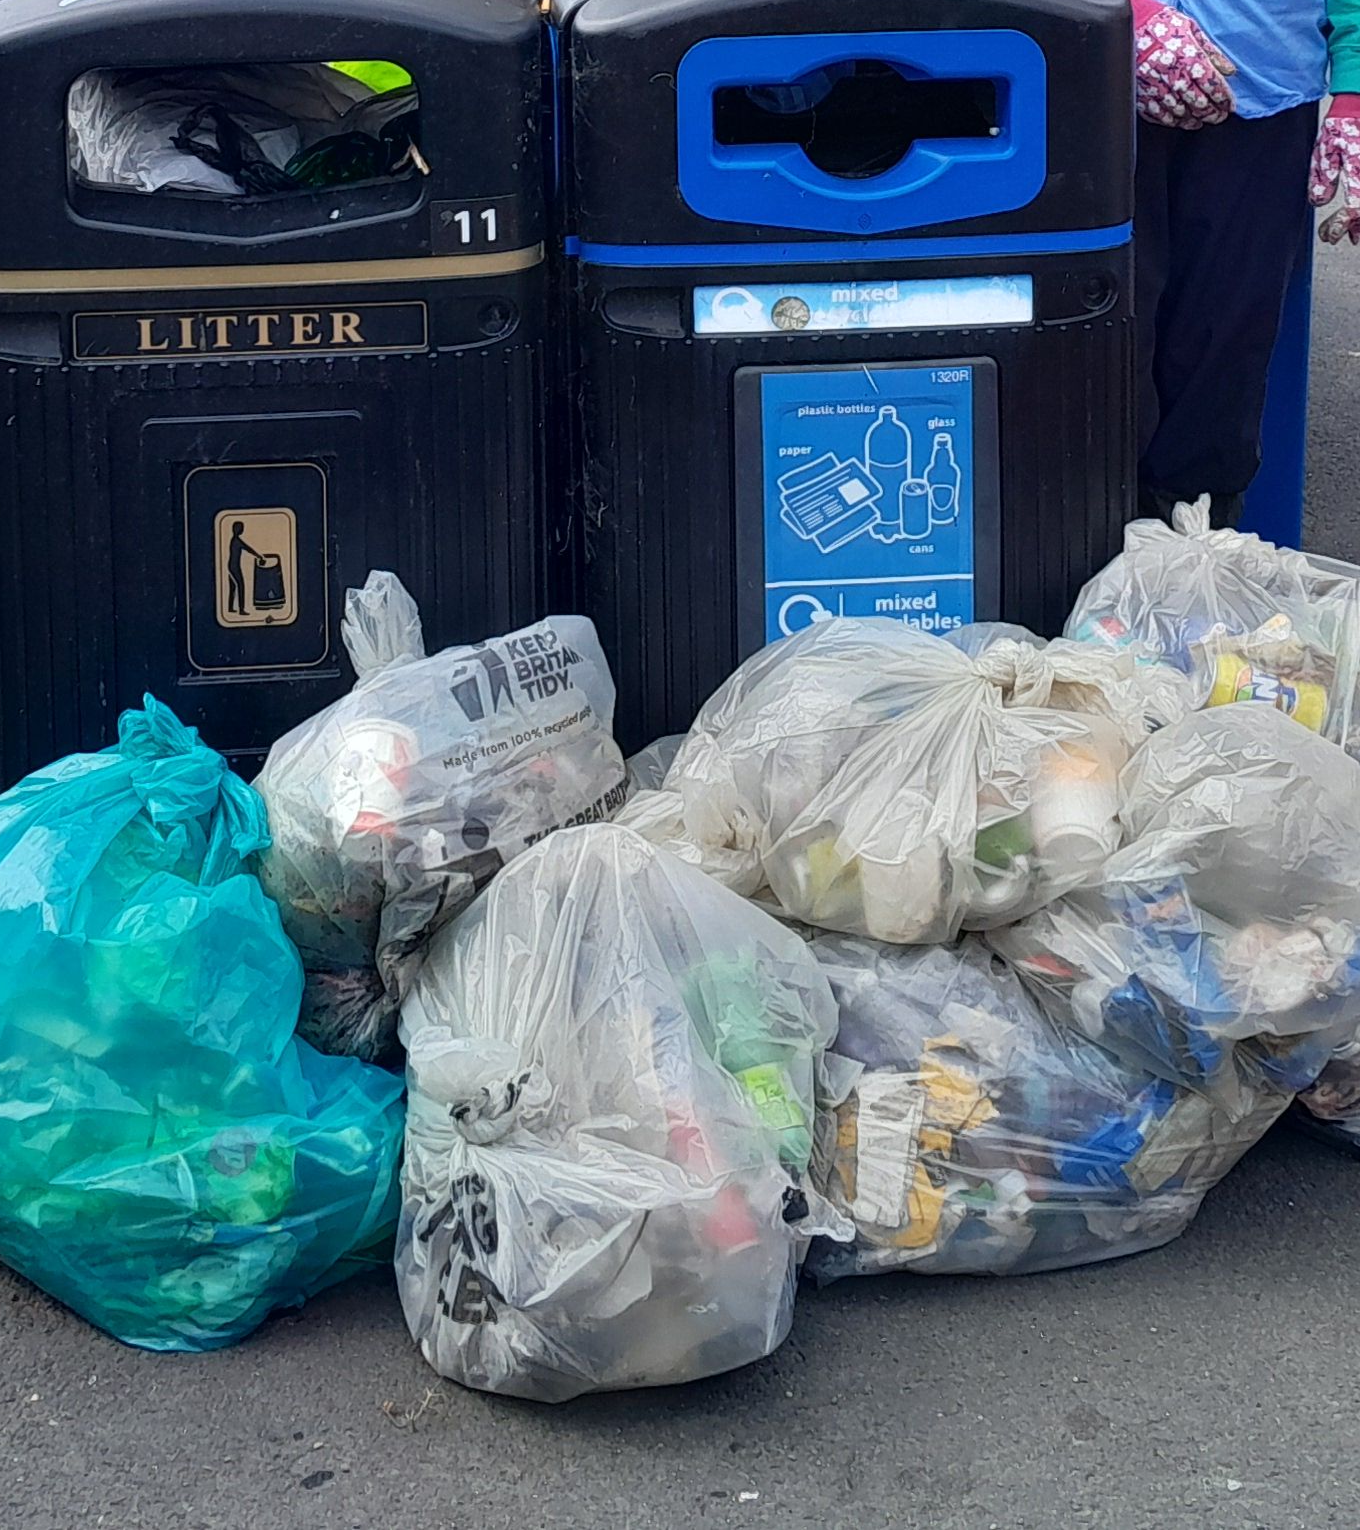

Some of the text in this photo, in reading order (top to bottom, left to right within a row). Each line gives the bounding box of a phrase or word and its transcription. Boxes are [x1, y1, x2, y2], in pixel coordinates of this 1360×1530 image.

[454, 208, 497, 243] 11
[831, 280, 899, 303] mixed
[137, 311, 365, 350] LITTER
[797, 403, 876, 418] plastic bottles
[927, 416, 956, 430] glass
[778, 446, 812, 457] paper
[908, 543, 934, 553] cans
[875, 591, 937, 612] mixed
[520, 669, 574, 703] TIDY.
[443, 751, 478, 769] Made
[481, 740, 509, 757] from
[511, 726, 543, 747] 100%
